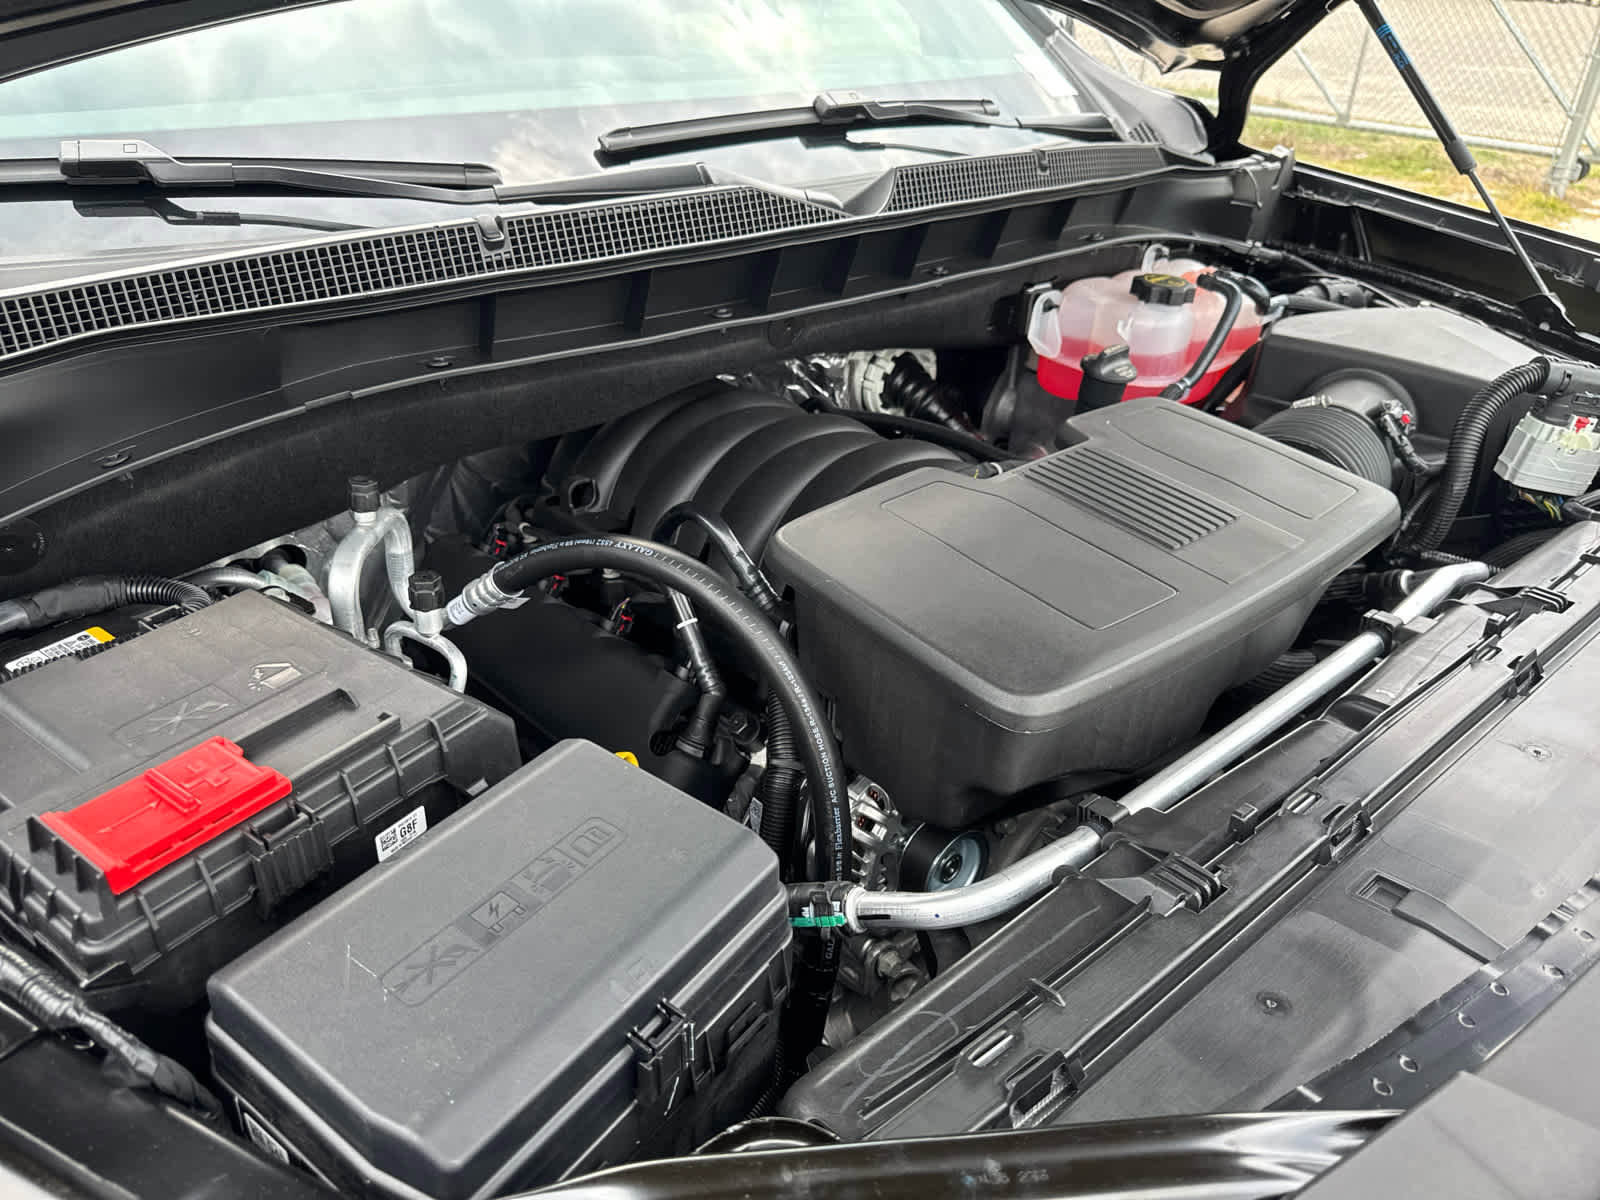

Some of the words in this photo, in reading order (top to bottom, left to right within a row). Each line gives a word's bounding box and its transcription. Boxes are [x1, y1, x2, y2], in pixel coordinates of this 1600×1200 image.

[614, 541, 654, 556] GALAXY
[813, 726, 826, 752] HOSE
[821, 751, 836, 788] SUCTION
[400, 818, 417, 837] G8F
[832, 807, 843, 850] Flexbarrier
